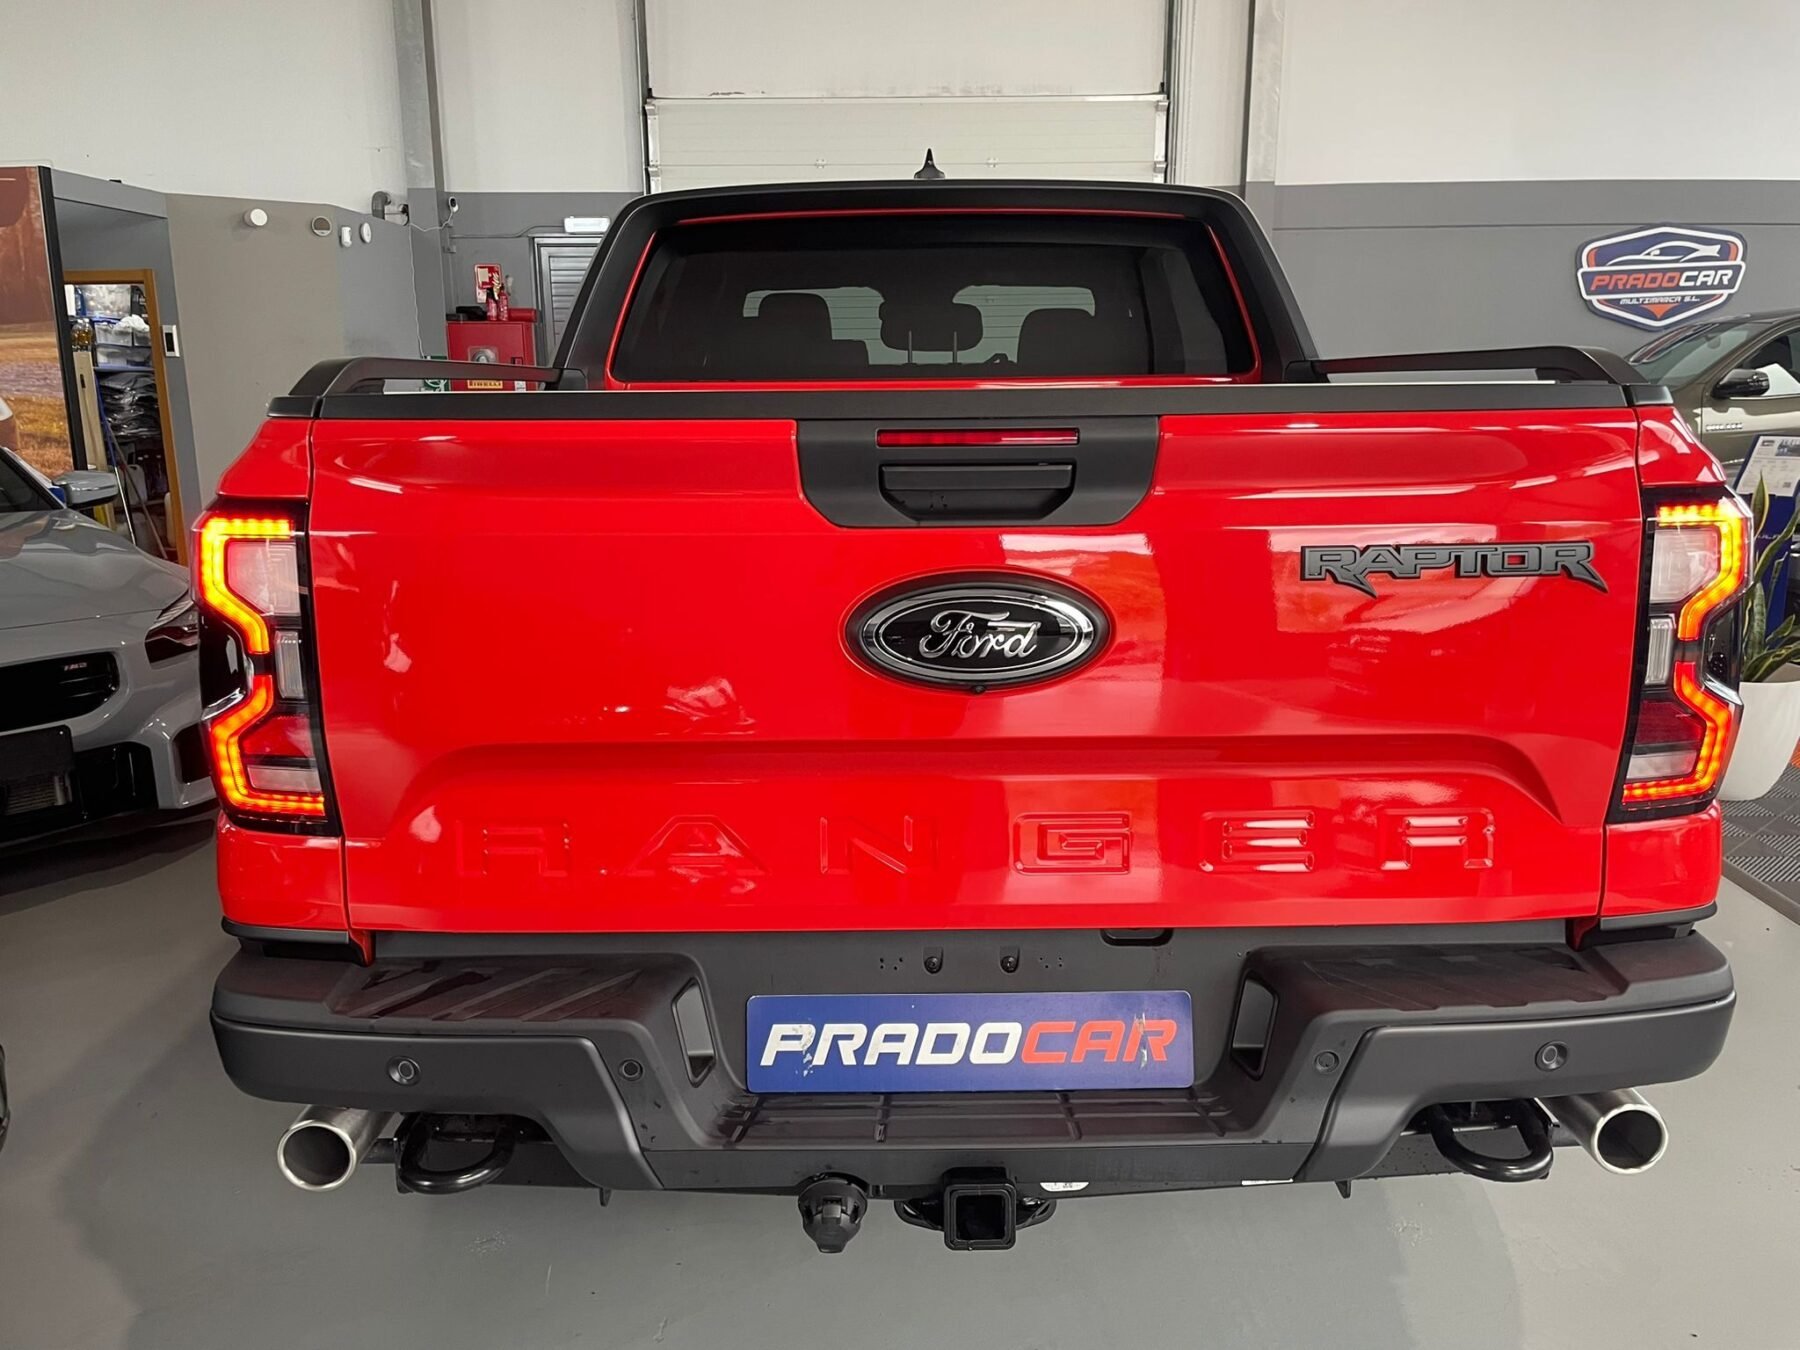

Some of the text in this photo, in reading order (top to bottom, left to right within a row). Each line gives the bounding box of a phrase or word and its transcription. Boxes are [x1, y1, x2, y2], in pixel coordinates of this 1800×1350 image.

[1590, 269, 1733, 291] PRADOCAR
[1619, 295, 1682, 305] MULTIMARCA
[1300, 540, 1609, 599] RAPTOR
[919, 610, 1042, 658] Ford
[456, 807, 1494, 876] RANGER
[759, 1019, 1178, 1067] PRADOCAR
